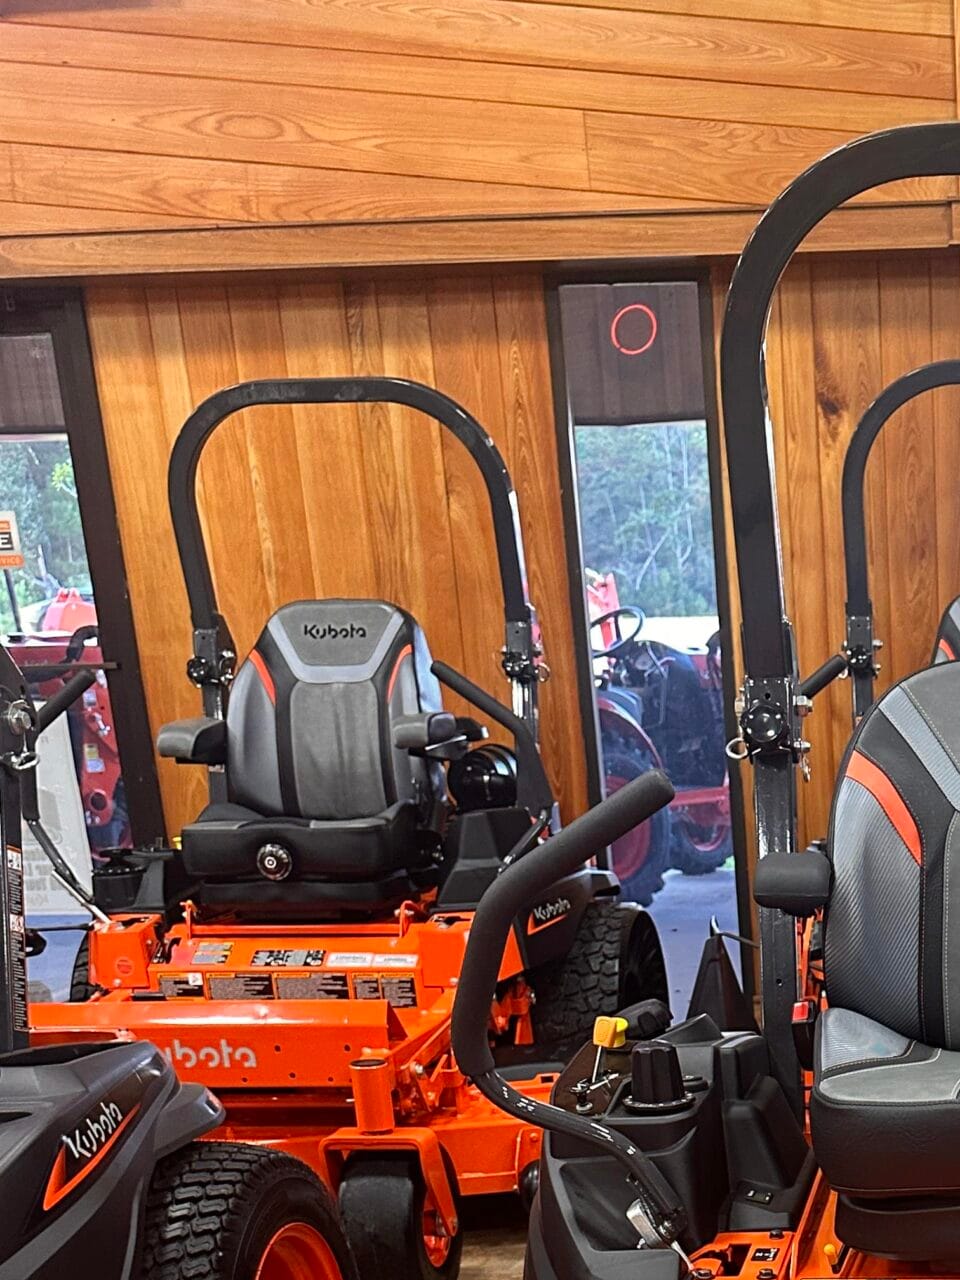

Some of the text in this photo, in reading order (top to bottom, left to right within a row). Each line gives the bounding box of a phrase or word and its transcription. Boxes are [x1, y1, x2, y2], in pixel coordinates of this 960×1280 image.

[303, 622, 367, 640] Kubota
[533, 898, 571, 920] Kubota
[165, 1038, 258, 1069] bota
[61, 1101, 124, 1159] Kubota
